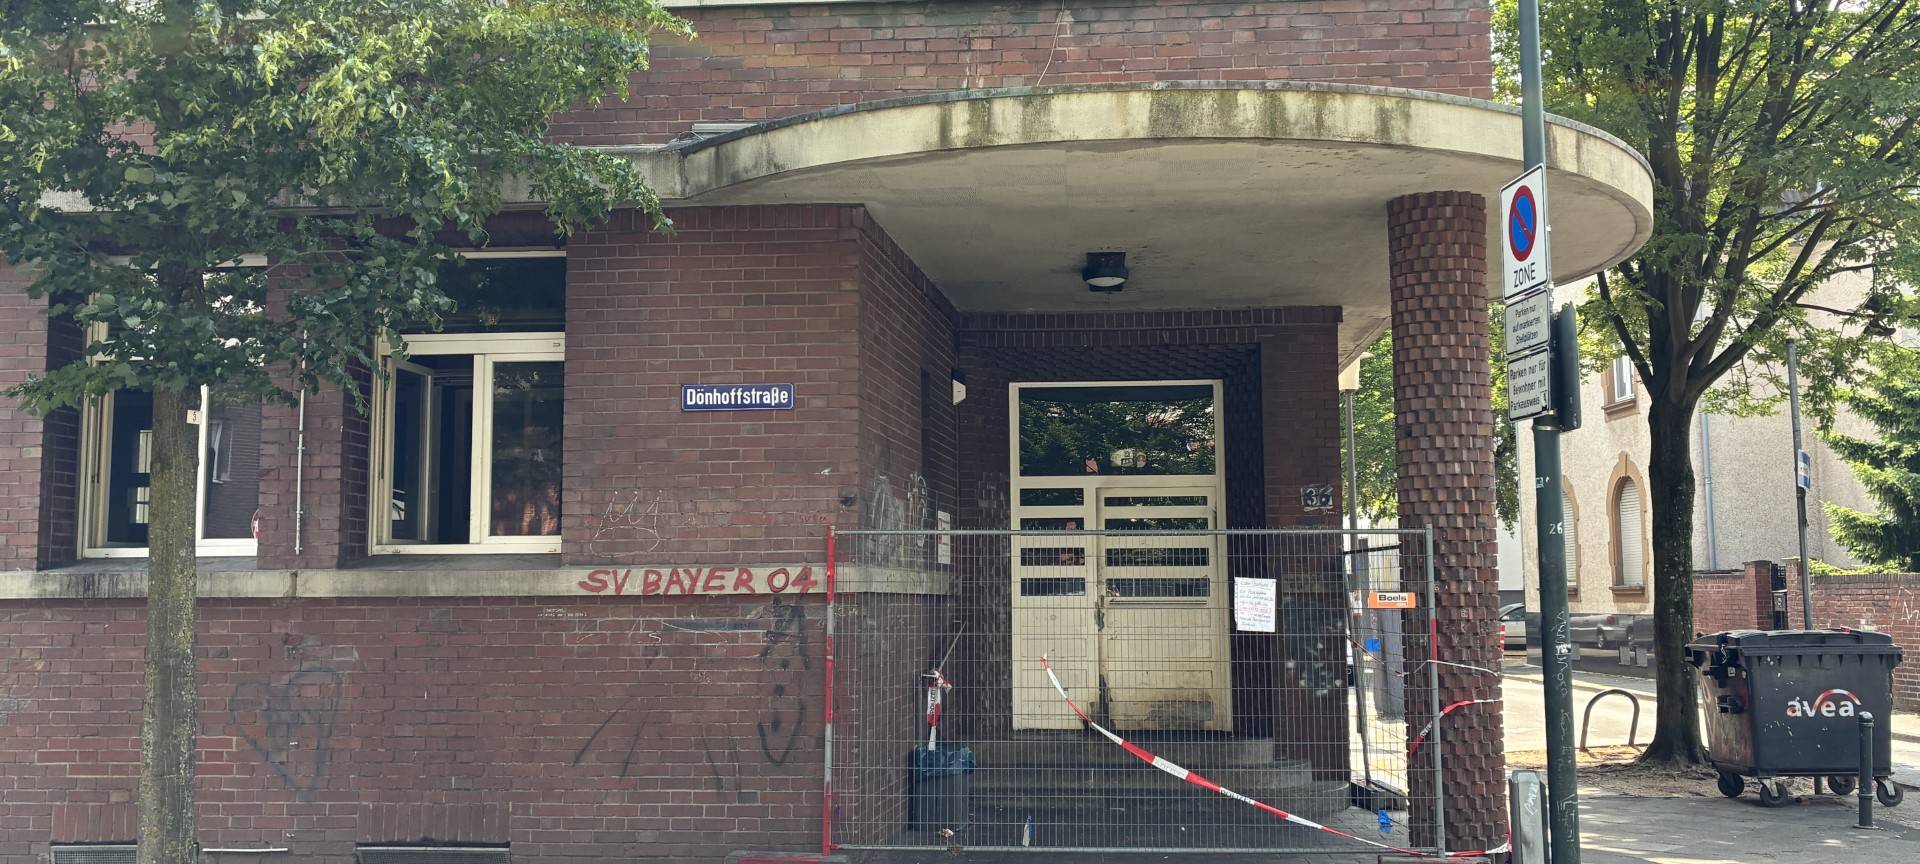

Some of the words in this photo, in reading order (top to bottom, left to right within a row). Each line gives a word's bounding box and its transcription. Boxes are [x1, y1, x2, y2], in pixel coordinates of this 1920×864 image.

[1513, 262, 1536, 288] ZONE
[1515, 306, 1529, 317] Parken
[1510, 367, 1527, 380] Parken
[1528, 364, 1537, 376] nur
[1538, 360, 1546, 372] für
[1513, 381, 1537, 396] Bewohner
[1538, 375, 1546, 389] mit
[686, 386, 789, 406] Dönhoffstraße
[1510, 395, 1540, 412] Parkausweis
[1549, 521, 1563, 535] 26
[578, 568, 632, 595] SV
[642, 567, 756, 595] BAYER
[1786, 692, 1859, 717] avea
